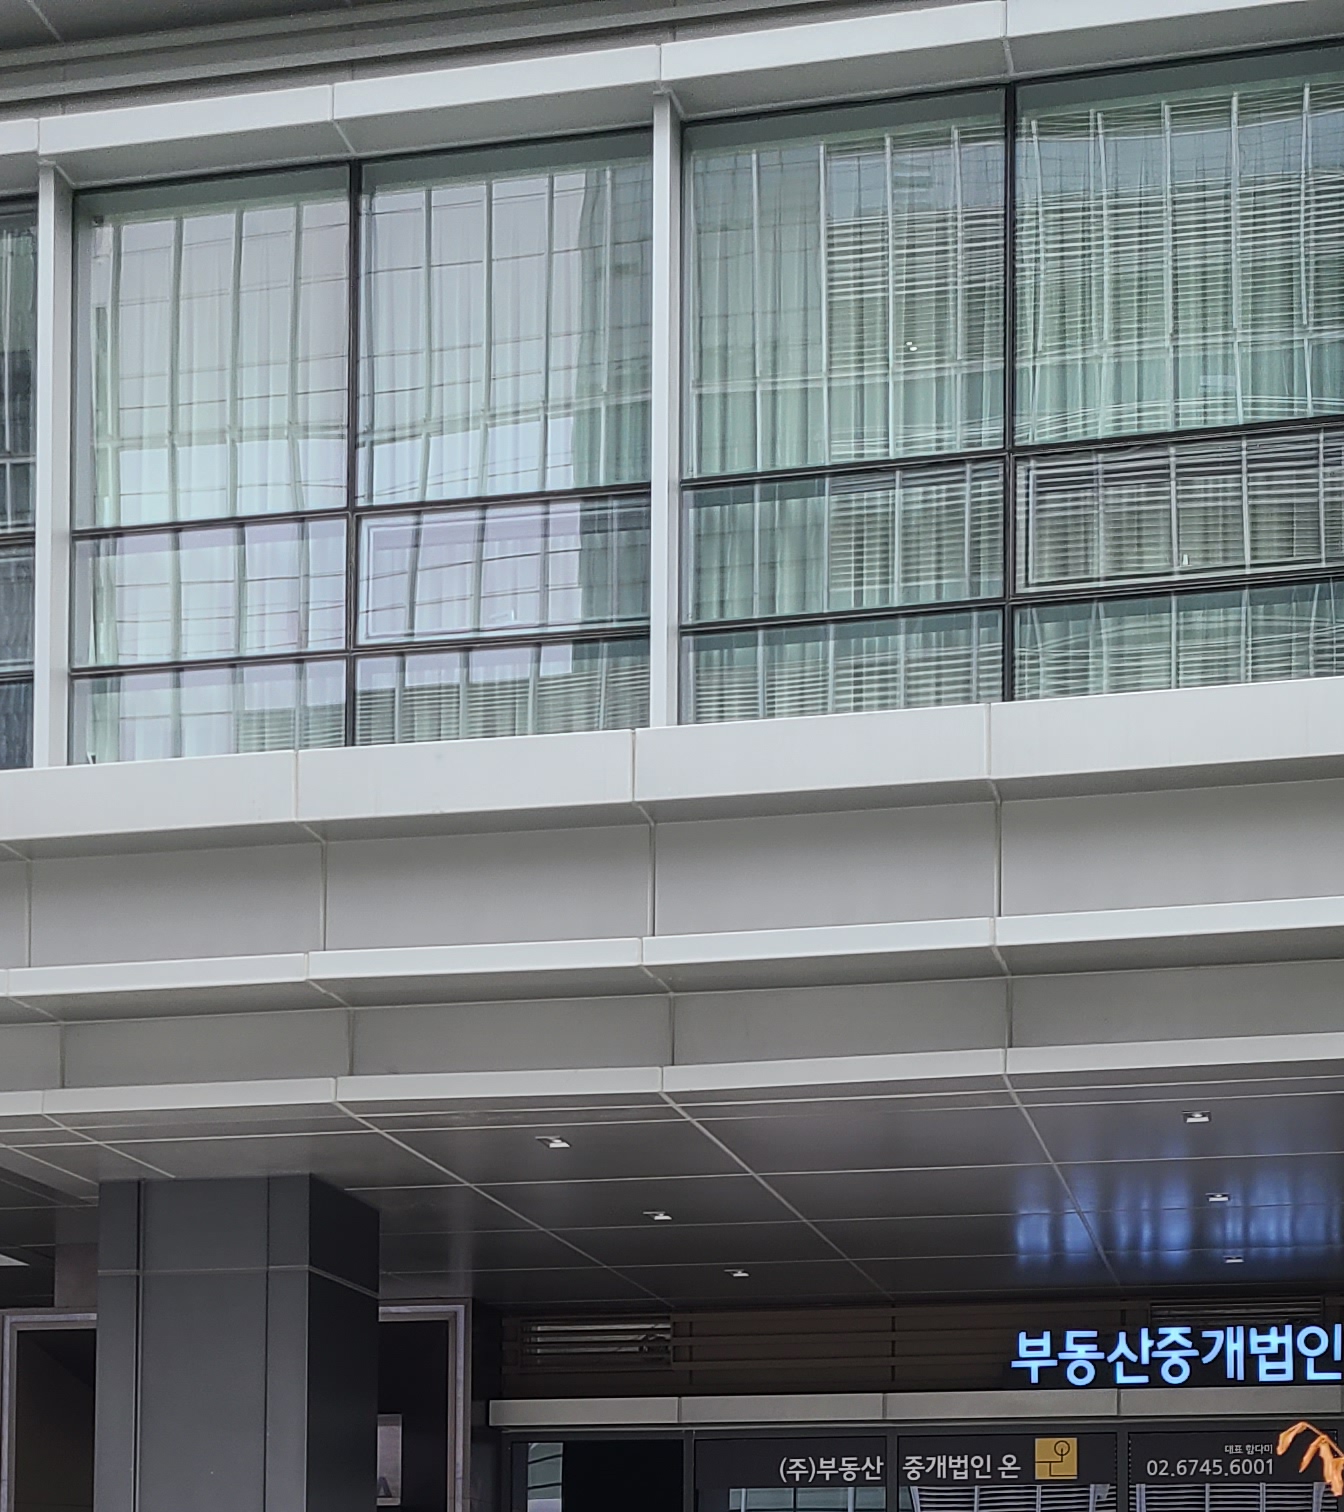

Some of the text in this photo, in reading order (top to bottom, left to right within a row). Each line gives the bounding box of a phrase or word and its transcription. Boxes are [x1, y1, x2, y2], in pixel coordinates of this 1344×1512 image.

[1011, 1323, 1342, 1386] 부동산중개법인
[779, 1454, 1022, 1483] (주)부동산 중개법인 온
[1146, 1458, 1274, 1477] 02.6745.6001
